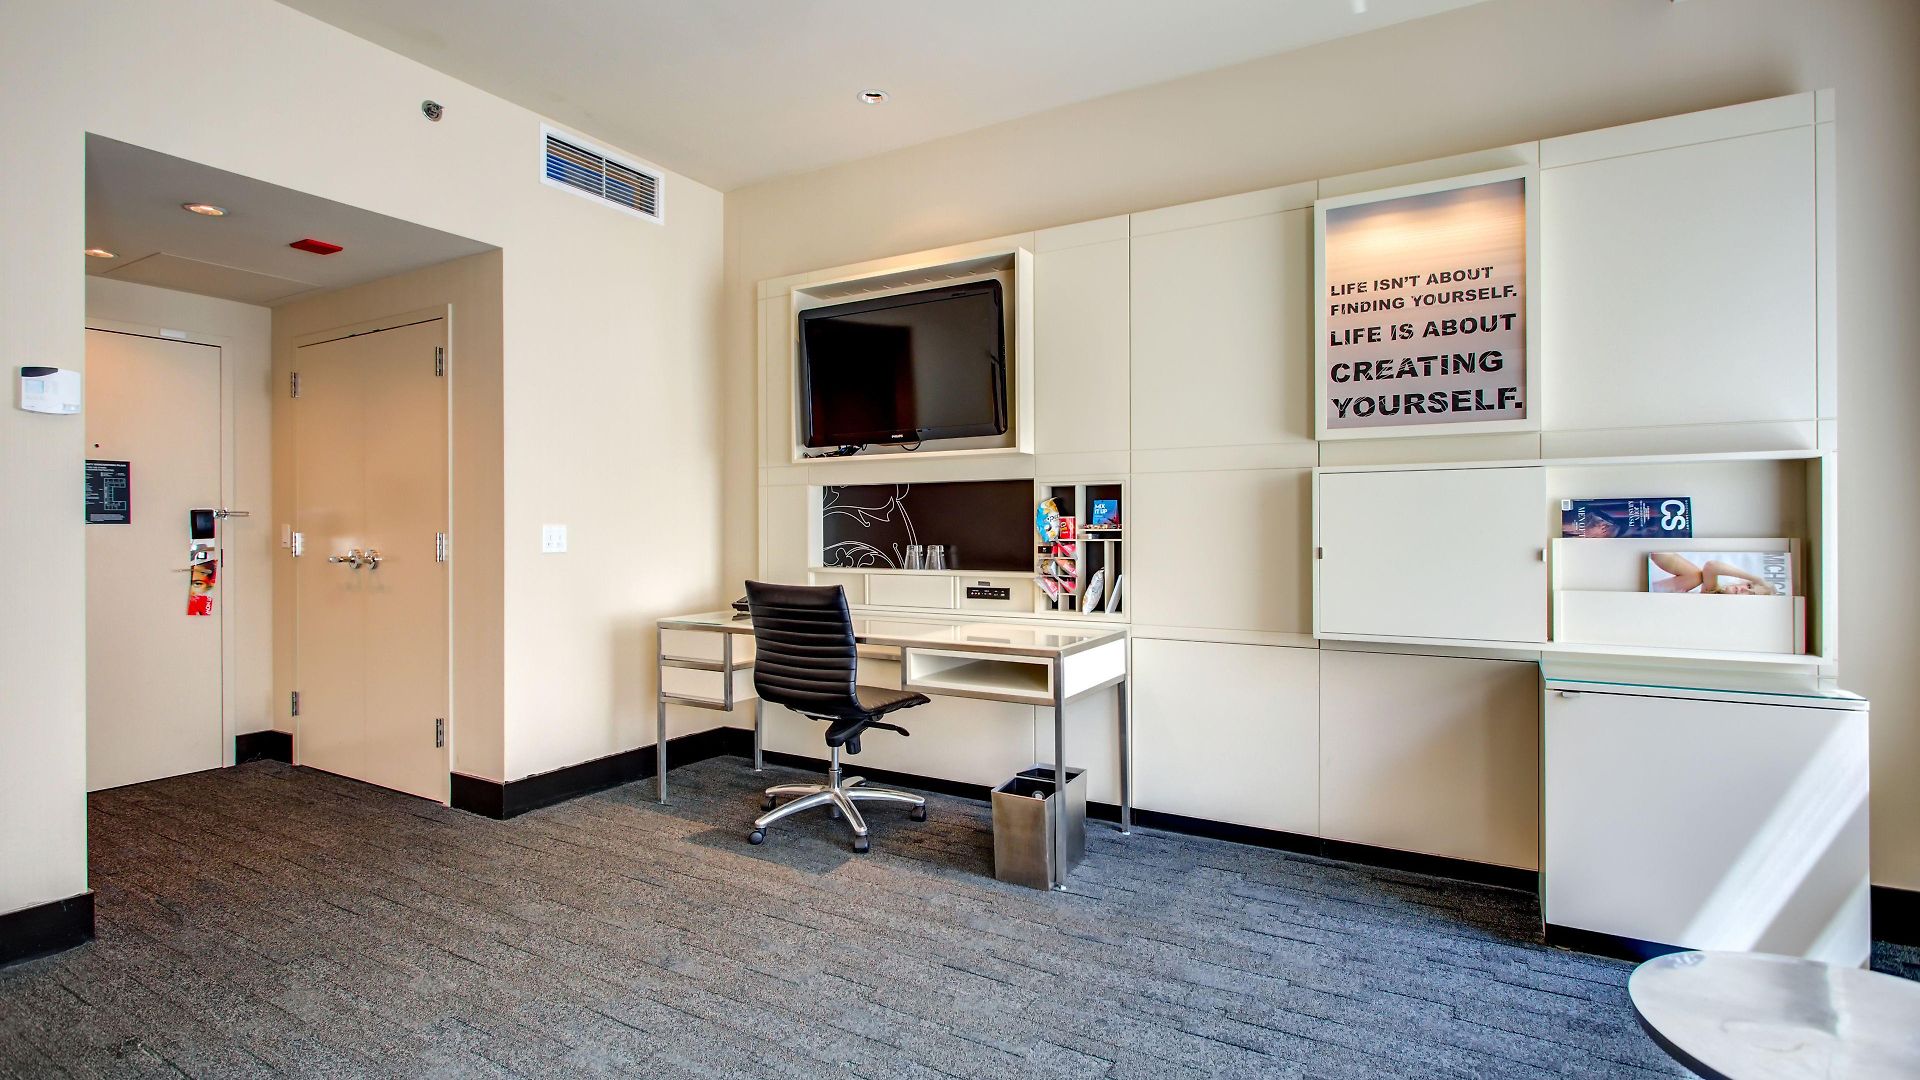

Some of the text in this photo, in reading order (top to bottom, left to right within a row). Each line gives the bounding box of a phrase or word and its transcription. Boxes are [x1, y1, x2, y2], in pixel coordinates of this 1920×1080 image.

[1330, 266, 1494, 297] LIFE ISN'T ABOUT
[1330, 284, 1518, 316] FINDING YOURSELF.
[1330, 313, 1517, 347] LIFE IS ABOUT
[1330, 350, 1504, 383] CREATING
[1330, 386, 1523, 419] YOURSELF.
[1577, 506, 1586, 522] MEN
[1660, 499, 1684, 531] CS
